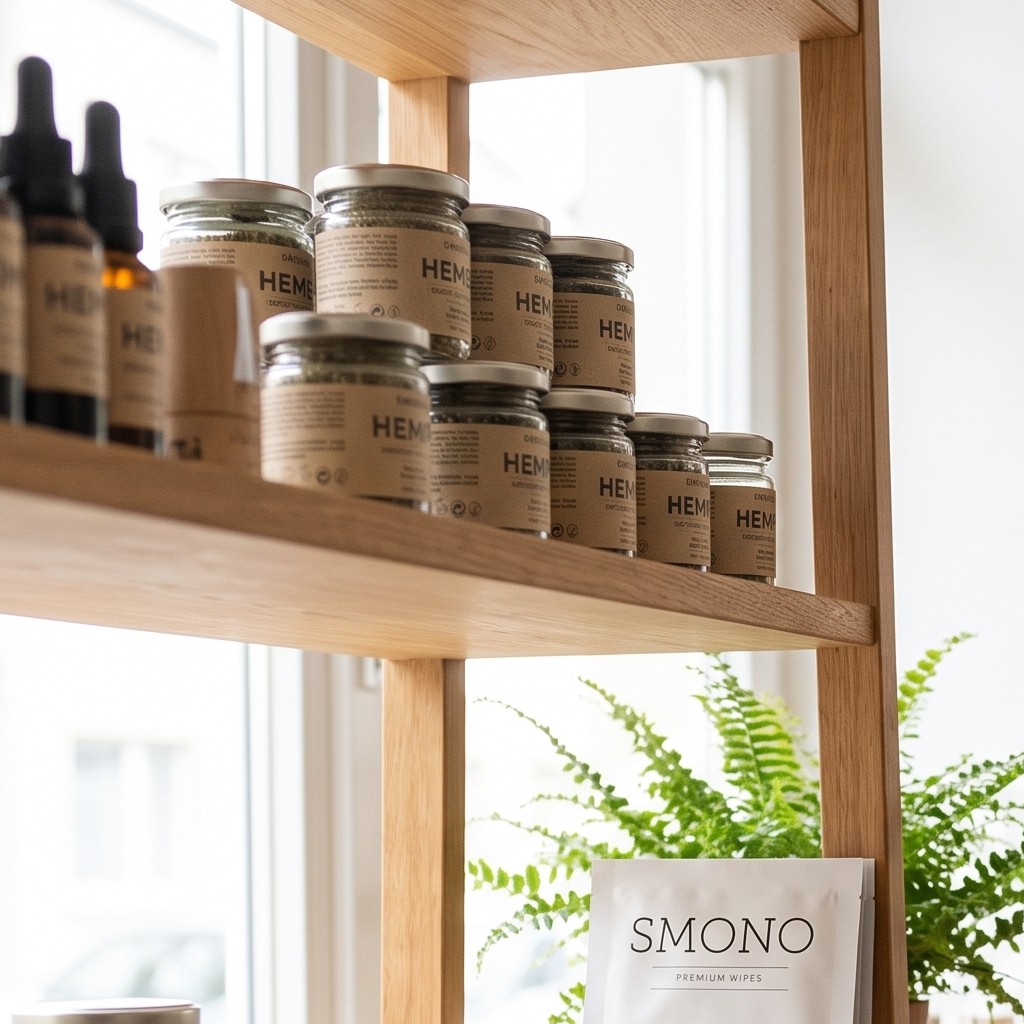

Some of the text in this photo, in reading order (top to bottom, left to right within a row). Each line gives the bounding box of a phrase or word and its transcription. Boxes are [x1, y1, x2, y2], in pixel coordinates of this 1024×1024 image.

[630, 916, 814, 954] SMONO
[676, 973, 762, 982] PREMIUM WIPES
